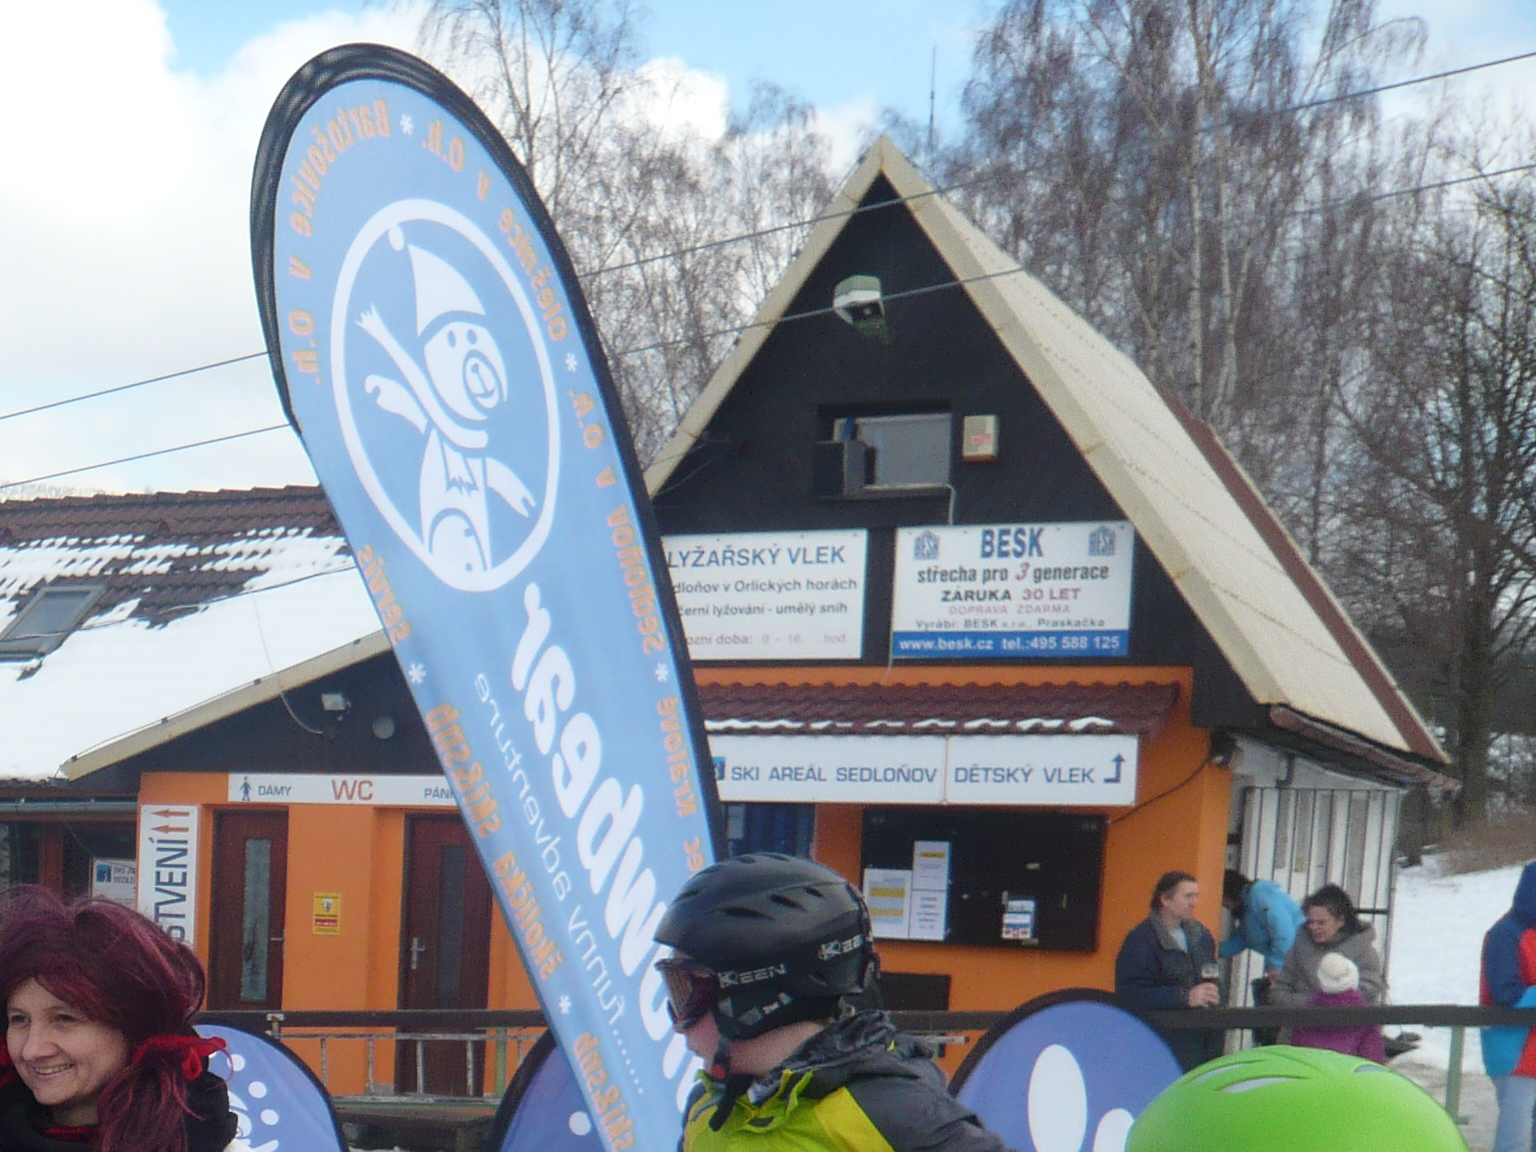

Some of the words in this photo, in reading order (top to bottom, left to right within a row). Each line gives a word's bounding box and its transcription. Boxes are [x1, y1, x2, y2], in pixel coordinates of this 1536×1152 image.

[980, 526, 1045, 559] BESK
[667, 542, 781, 568] LYŽAŘSKÝ
[787, 545, 846, 564] VLEK
[917, 565, 977, 584] střecha
[981, 567, 1009, 584] pro
[1015, 562, 1031, 582] 3
[1032, 564, 1110, 583] generace
[672, 581, 720, 594] dloňov
[723, 583, 731, 592] v
[734, 579, 802, 595] Orlických
[806, 577, 857, 591] horách
[941, 585, 1012, 602] ZÁRUKA
[1021, 588, 1044, 601] 30
[1049, 588, 1081, 601] LET
[677, 604, 709, 616] černí
[713, 604, 764, 618] lyžování
[776, 603, 815, 616] umělý
[819, 602, 848, 614] sníh
[949, 604, 1008, 615] DOPRAVA
[1017, 604, 1071, 615] ZDARMA
[964, 619, 998, 629] BESK
[716, 634, 753, 645] doba:
[899, 637, 995, 651] www.besk.cz
[1061, 635, 1088, 649] 588
[1093, 635, 1120, 649] 125
[731, 767, 760, 782] SKI
[769, 762, 827, 782] AREÁL
[836, 762, 938, 783] SEDLOŇOV
[954, 762, 1034, 783] DĚTSKÝ
[1044, 767, 1096, 783] VLEK
[258, 785, 293, 797] DÁMY
[331, 779, 374, 801] WC
